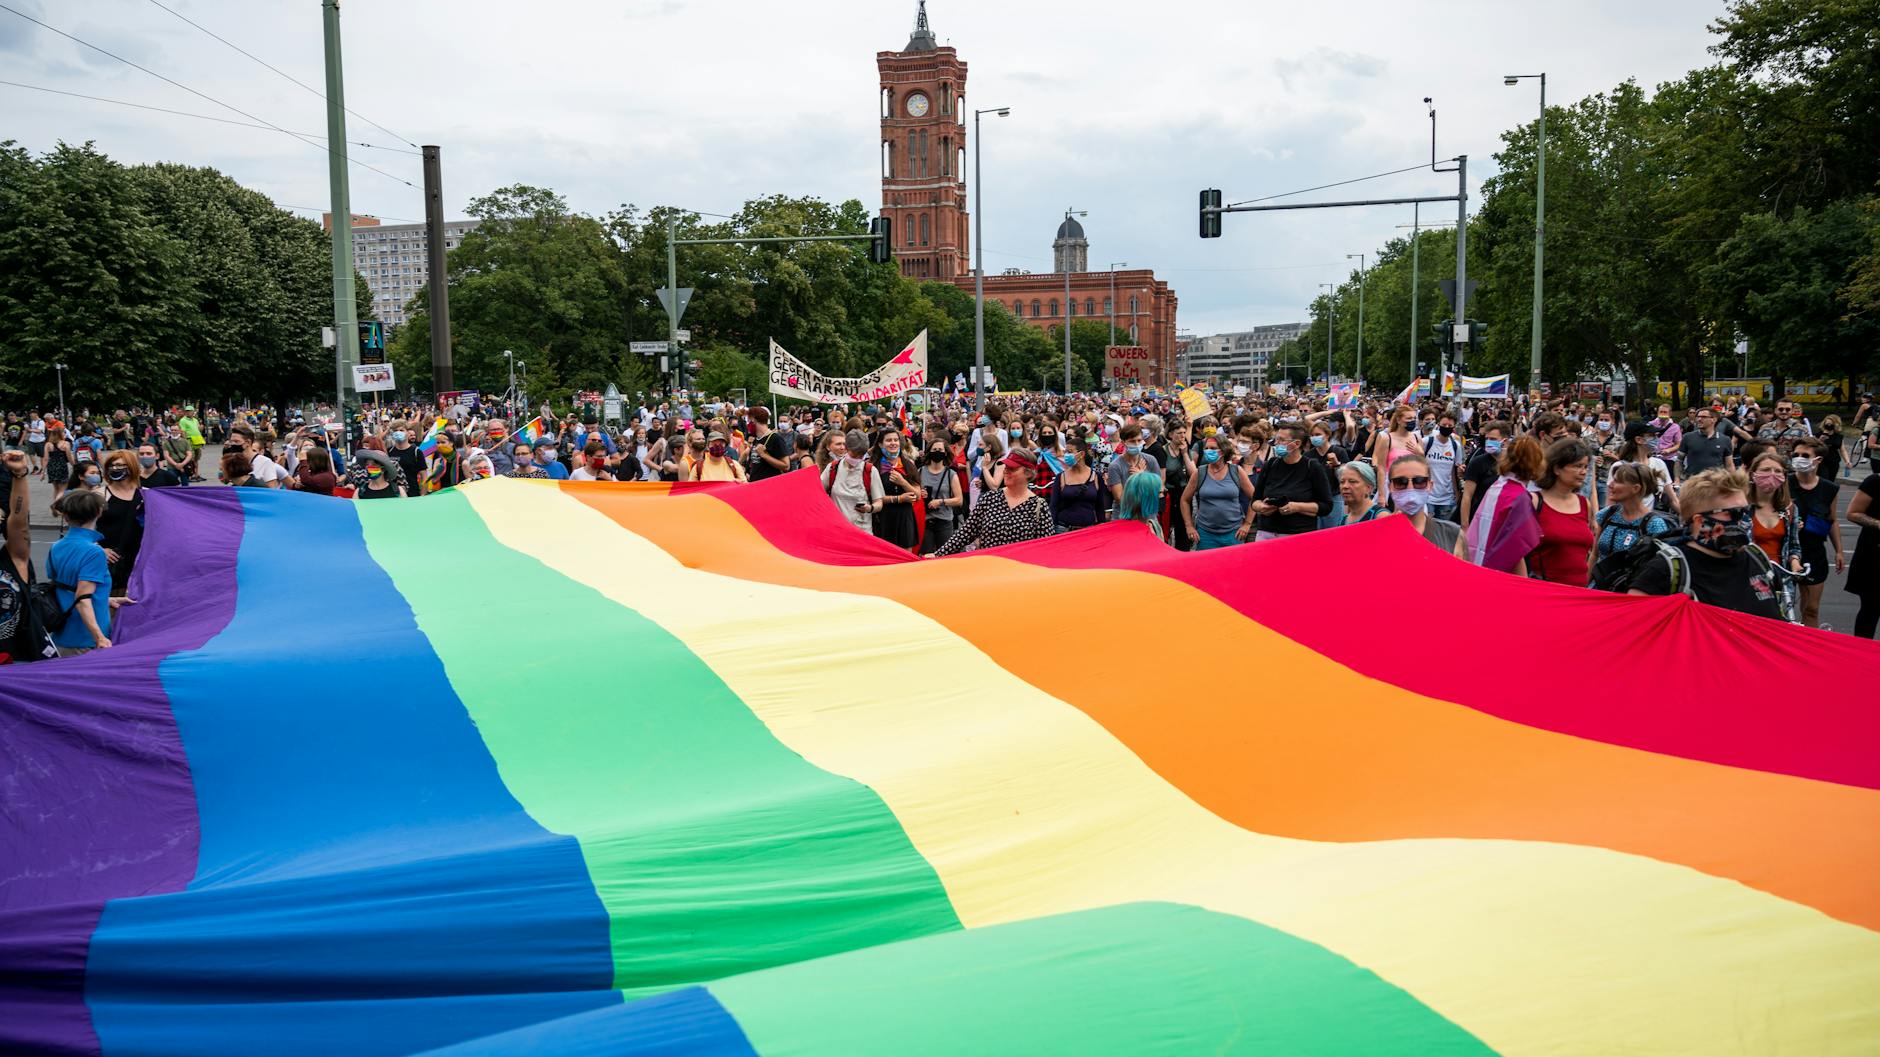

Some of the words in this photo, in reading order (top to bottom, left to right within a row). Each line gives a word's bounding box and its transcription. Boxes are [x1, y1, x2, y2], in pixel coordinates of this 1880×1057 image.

[1109, 347, 1148, 359] QUEERS
[773, 356, 811, 381] GEGEN
[1113, 366, 1139, 378] BLM
[812, 382, 860, 397] ARMUT
[850, 370, 925, 402] SOLIDARITÄT
